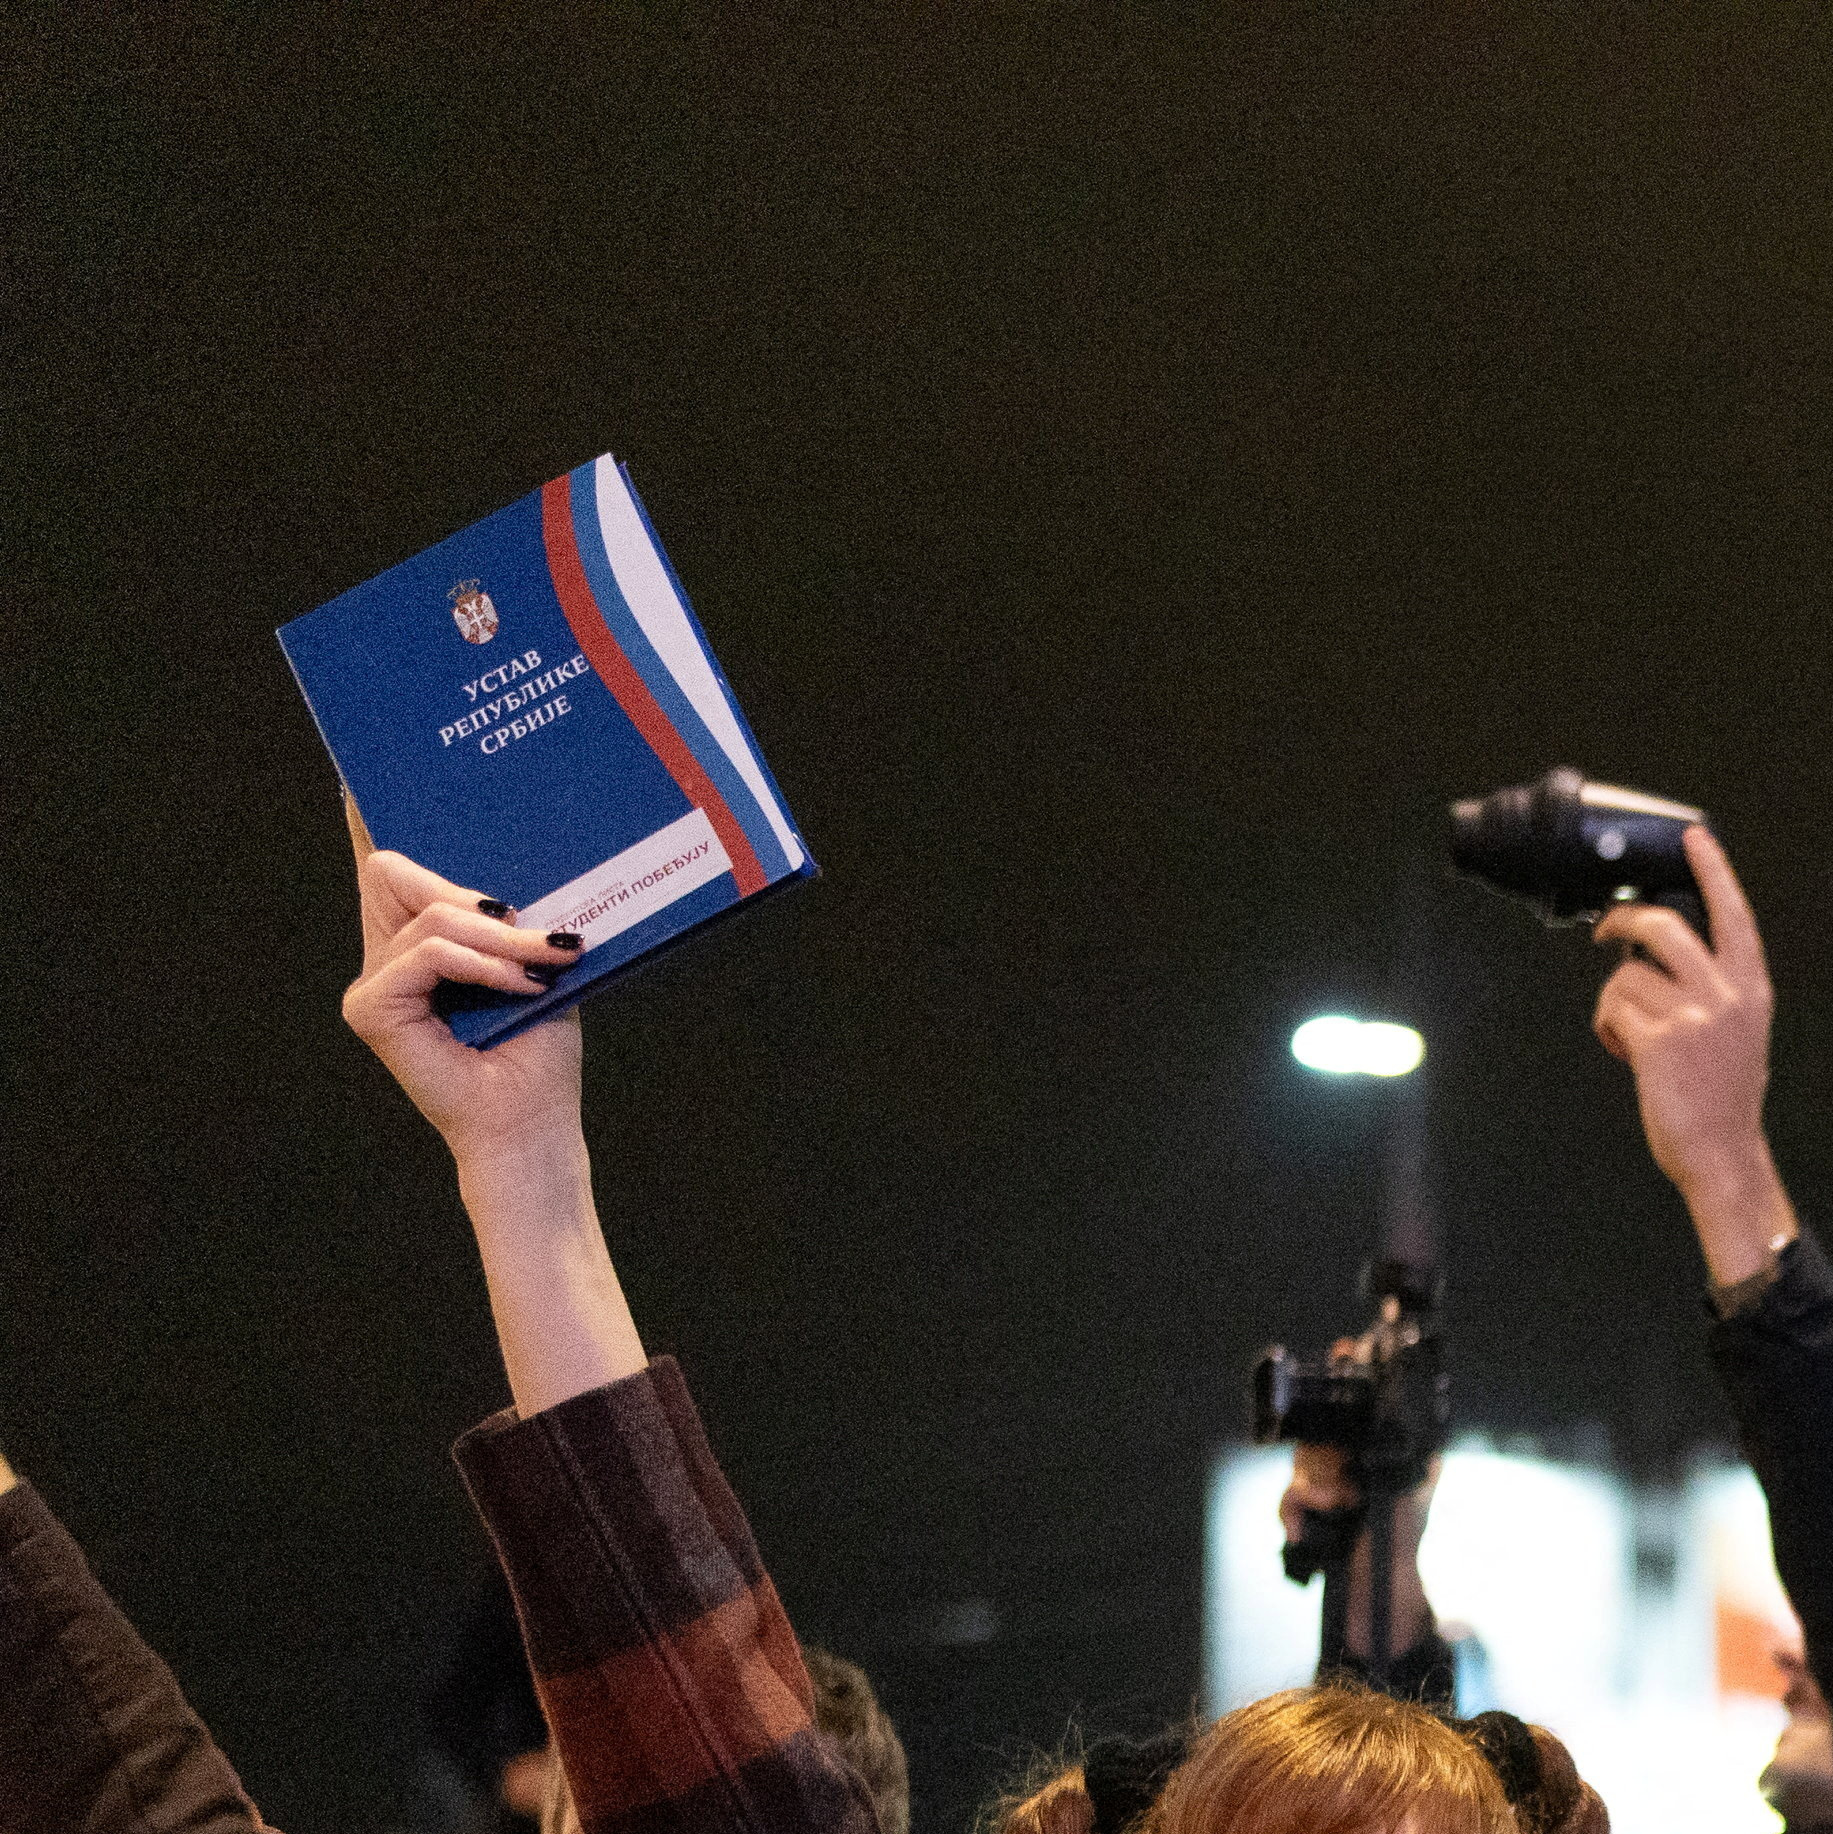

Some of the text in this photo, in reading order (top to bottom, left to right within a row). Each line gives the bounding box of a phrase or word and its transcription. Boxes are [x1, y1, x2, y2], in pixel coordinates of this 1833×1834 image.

[438, 654, 590, 747] РЕПУБЛИКЕ
[462, 650, 542, 702] УСТАВ
[480, 695, 572, 754] СРБИЈЕ
[631, 841, 709, 895] ПОБЕЂУЈУ
